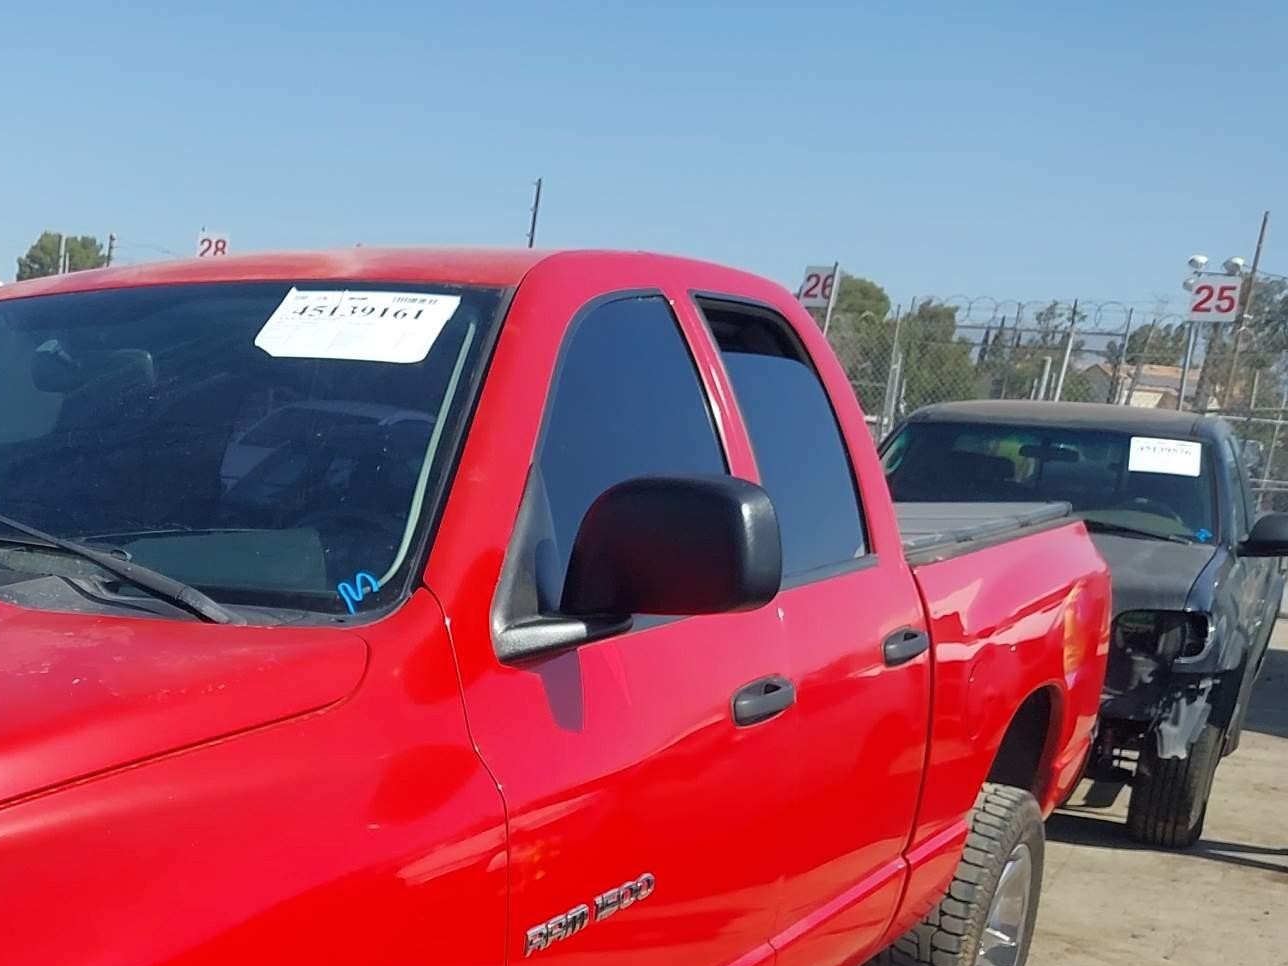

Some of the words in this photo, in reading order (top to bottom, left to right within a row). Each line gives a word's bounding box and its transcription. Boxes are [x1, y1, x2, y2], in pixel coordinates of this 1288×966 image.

[199, 237, 227, 257] 28
[803, 272, 833, 300] 26
[1191, 284, 1238, 313] 25
[292, 304, 425, 320] 45139161
[523, 903, 590, 958] RAM
[593, 872, 656, 923] 1500
